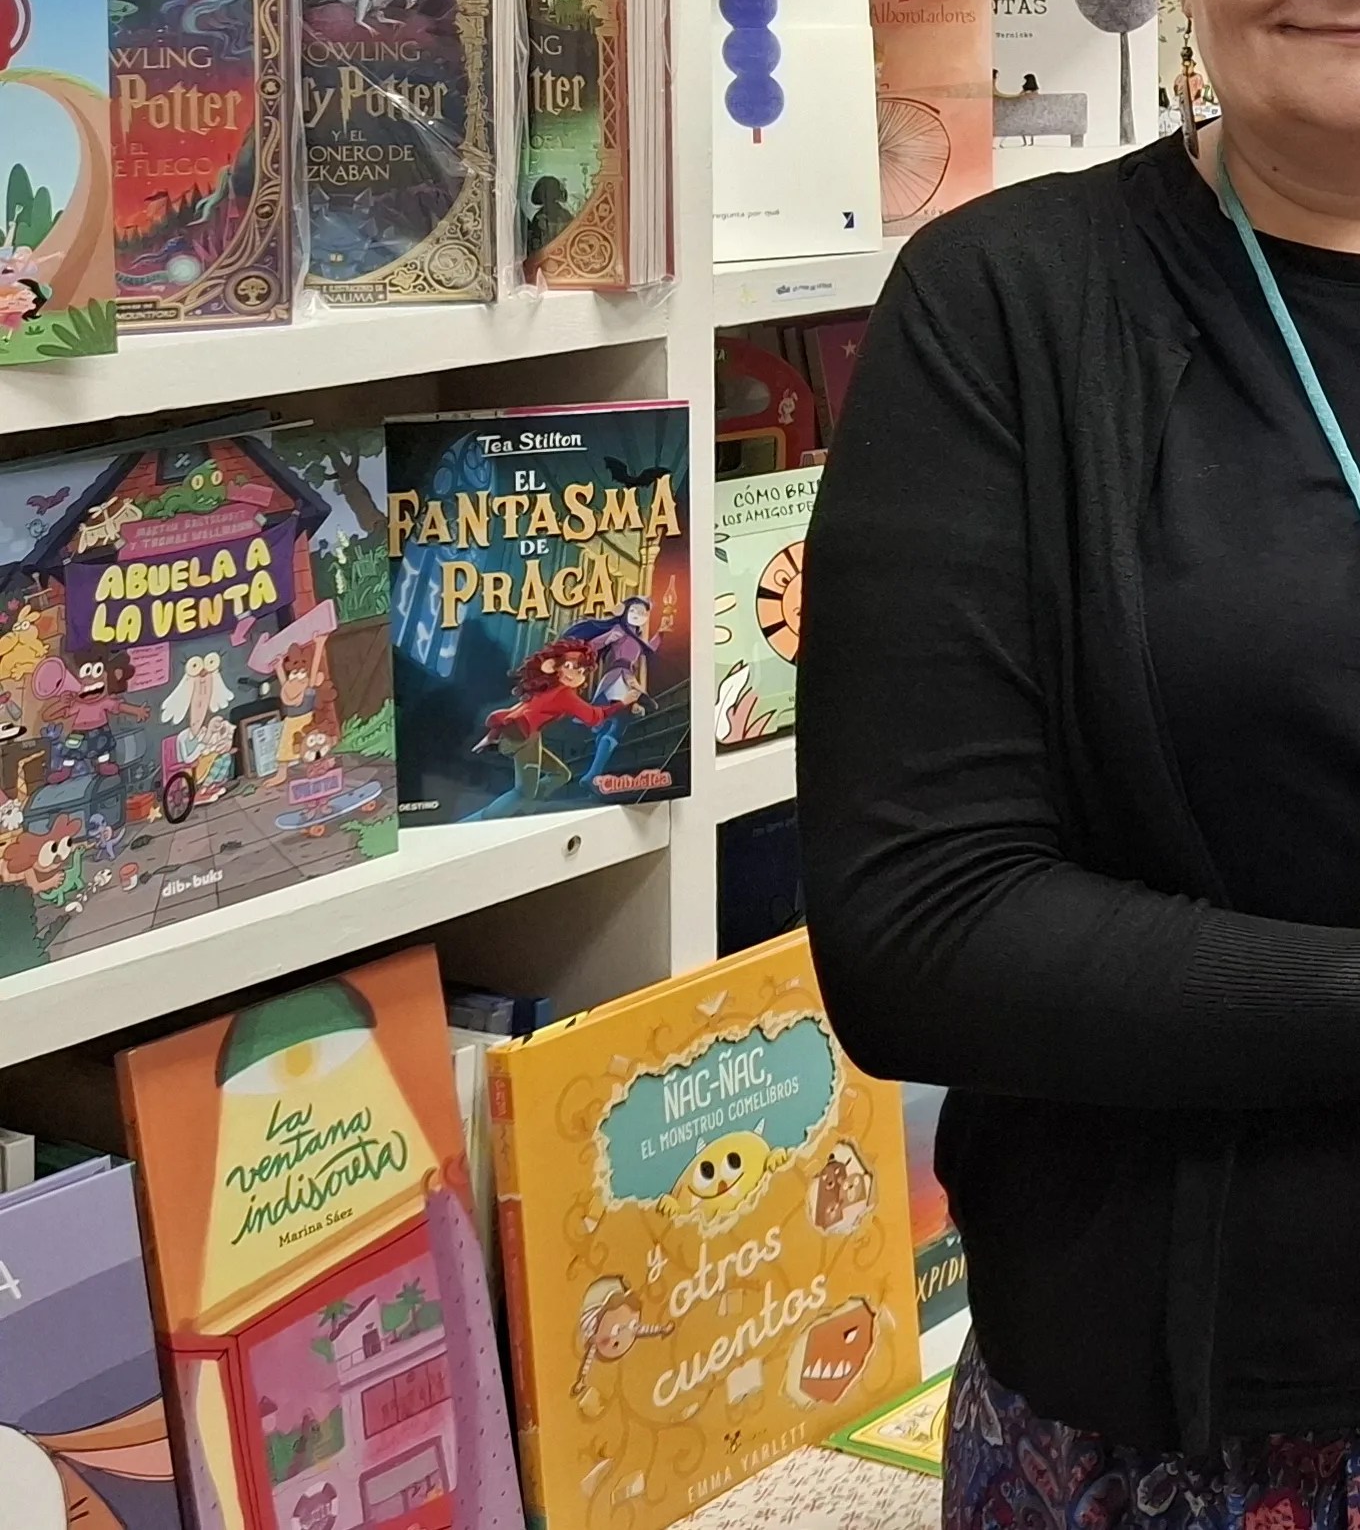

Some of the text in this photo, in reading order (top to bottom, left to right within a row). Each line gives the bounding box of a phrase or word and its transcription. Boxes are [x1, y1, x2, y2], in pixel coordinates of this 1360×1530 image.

[116, 72, 243, 146] Potter
[336, 65, 449, 134] Potter
[350, 130, 367, 143] EL
[389, 144, 415, 163] DE
[133, 157, 215, 178] FUEGO
[477, 431, 583, 455] Tea Stilton
[514, 470, 547, 492] EL
[733, 483, 781, 510] CÓMO
[387, 473, 682, 559] FANTASMA
[721, 504, 795, 527] LOS AMIGOS
[94, 537, 272, 603] ABUELA A
[519, 537, 550, 557] DE
[91, 569, 279, 644] LA VENTA
[440, 553, 622, 630] PRAGA
[399, 800, 441, 813] DESTINO
[662, 1043, 774, 1125] ÑAC-ÑAC,
[267, 1099, 314, 1140] La
[639, 1075, 801, 1162] EL MONSTRUO COMELIBROS
[225, 1105, 373, 1194] ventana
[277, 1205, 355, 1249] Marina Sáez
[646, 1242, 669, 1282] y
[668, 1225, 783, 1318] otros
[650, 1272, 829, 1408] cuentos
[686, 1421, 809, 1507] EMMA YARLETT
